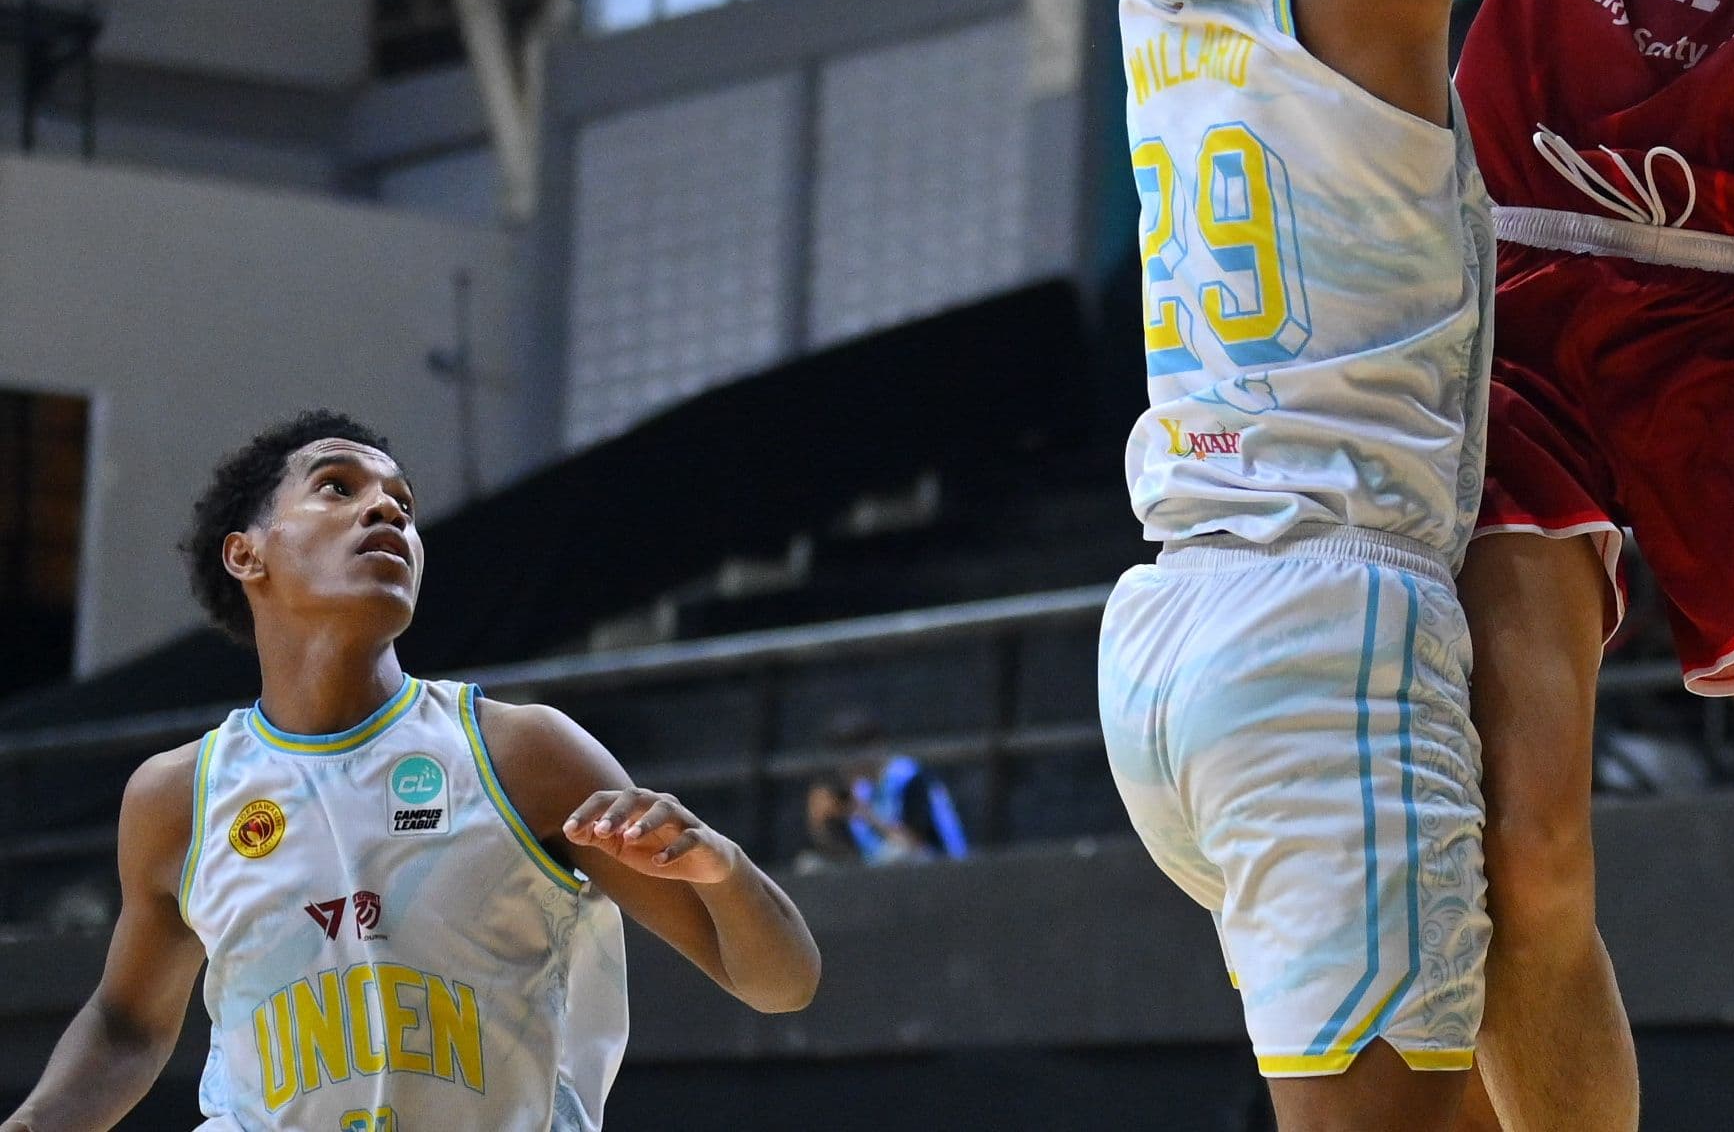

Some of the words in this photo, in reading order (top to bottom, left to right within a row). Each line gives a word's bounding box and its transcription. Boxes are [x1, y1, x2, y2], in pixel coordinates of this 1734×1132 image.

[1131, 122, 1304, 371] 29
[394, 809, 443, 821] CAMPUS
[394, 819, 440, 831] LEAGUE
[252, 962, 485, 1113] UNCEN
